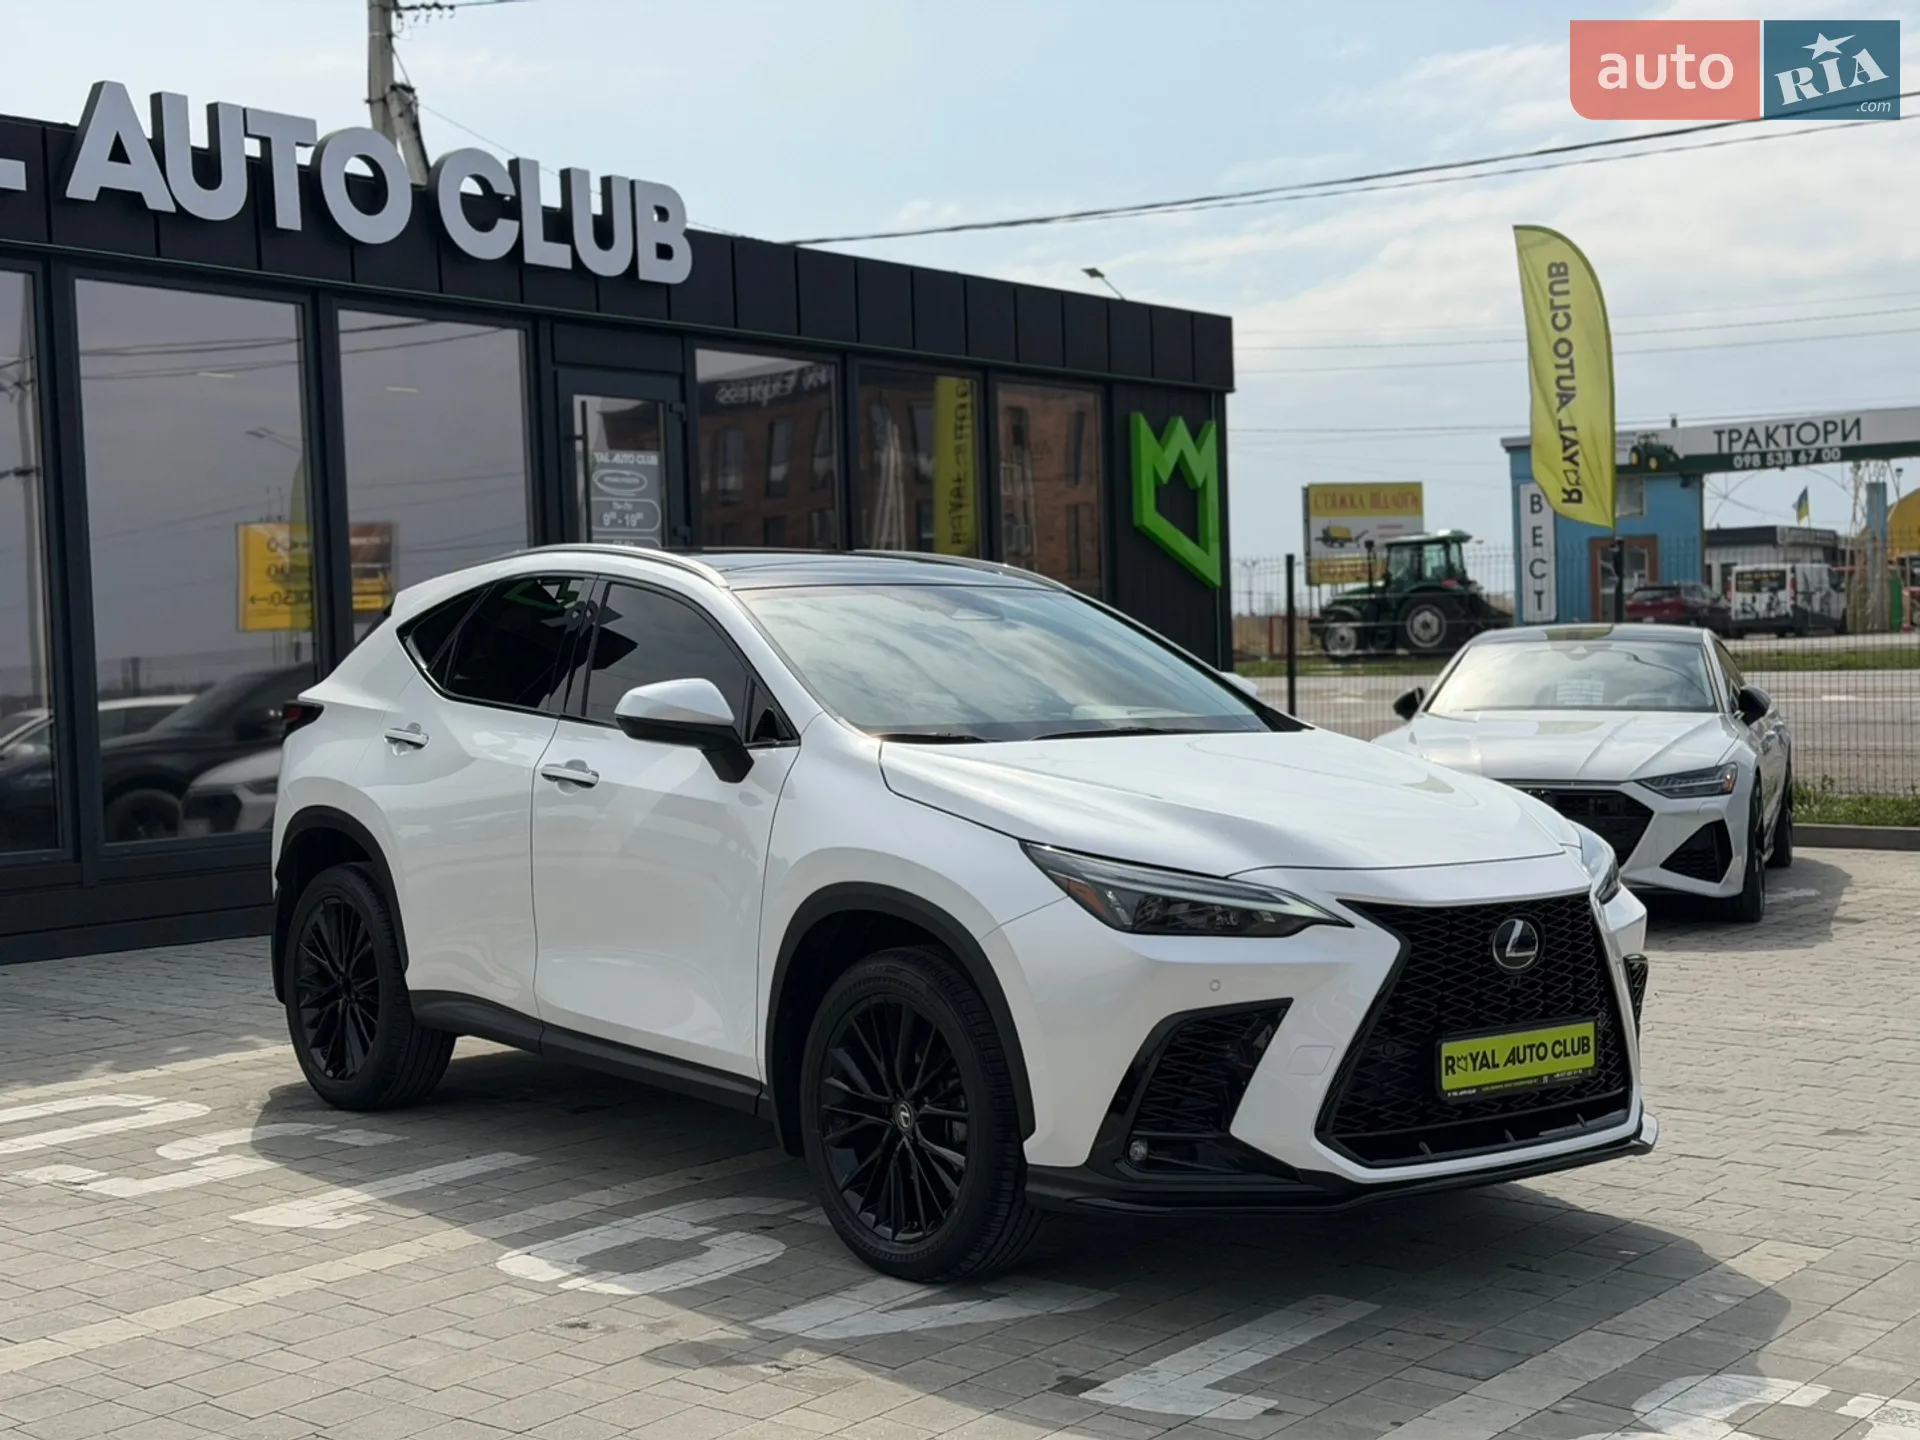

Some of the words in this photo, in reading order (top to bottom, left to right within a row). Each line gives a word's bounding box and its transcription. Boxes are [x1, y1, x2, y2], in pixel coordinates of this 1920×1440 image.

[65, 80, 412, 245] AUTO
[428, 147, 692, 284] CLUB
[1713, 417, 1861, 454] ТРАКТОРИ
[1733, 454, 1761, 469] 098
[1822, 447, 1841, 461] 00
[1529, 494, 1547, 611] ВЕСТ
[1503, 1042, 1548, 1067] AUTO
[1551, 1036, 1591, 1060] CLUB
